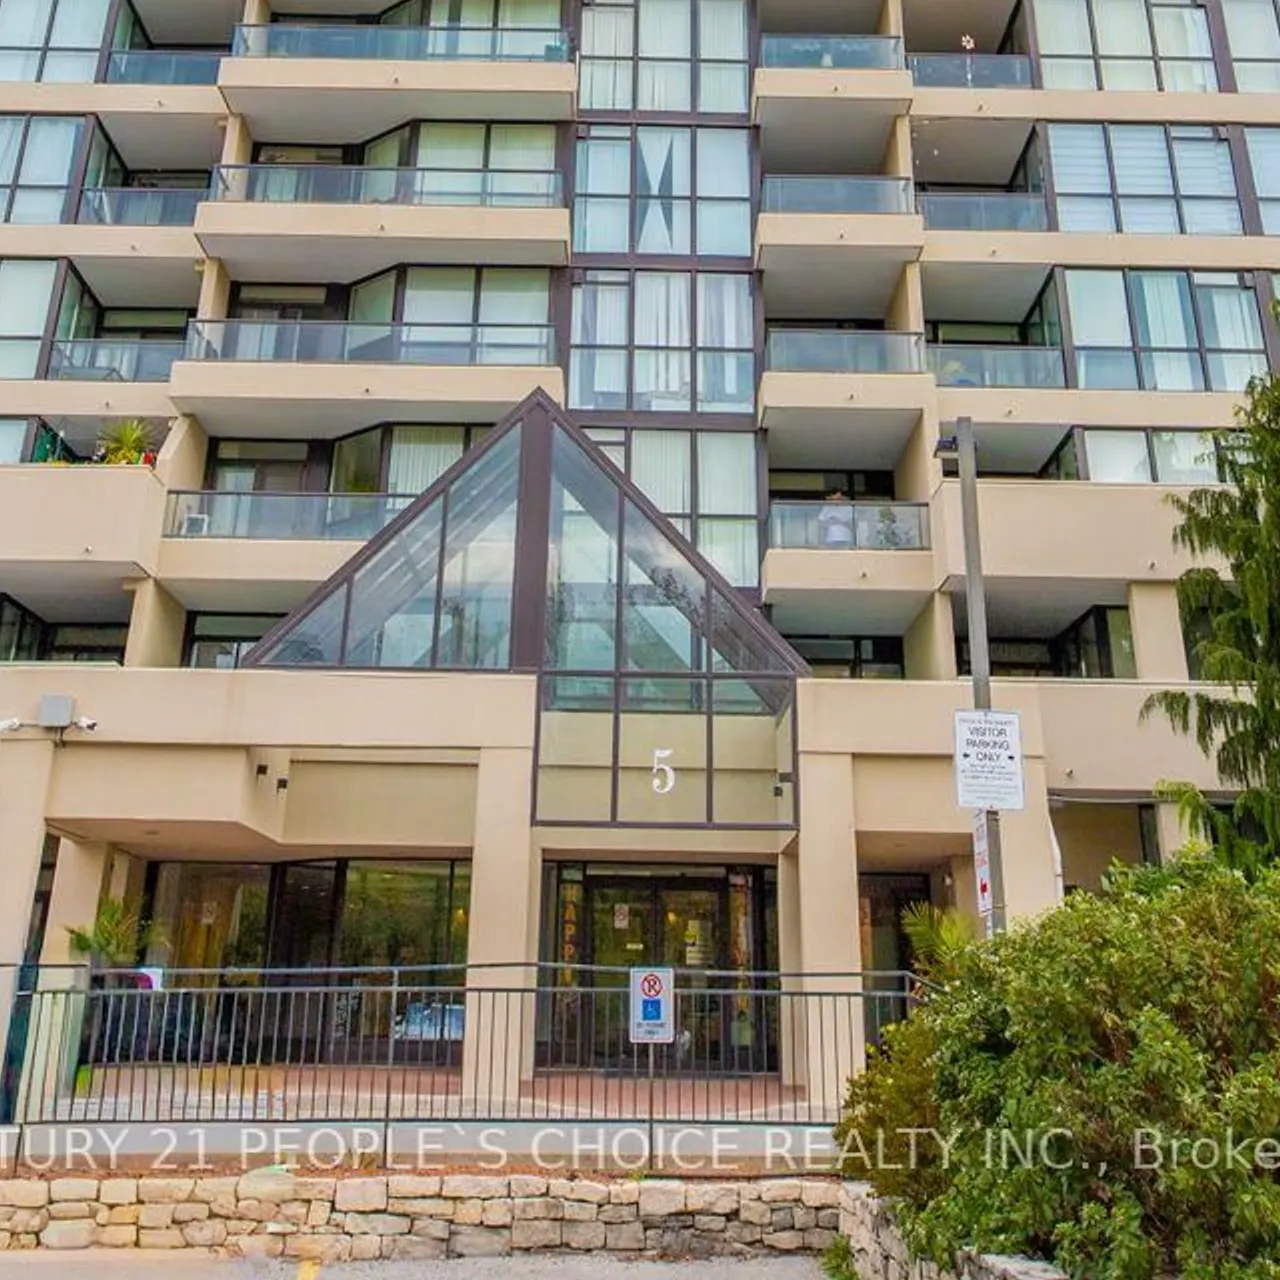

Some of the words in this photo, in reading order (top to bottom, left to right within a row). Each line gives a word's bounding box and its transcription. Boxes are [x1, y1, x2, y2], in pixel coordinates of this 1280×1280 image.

[968, 726, 1007, 737] VISITOR
[966, 738, 1010, 751] PARKING
[976, 751, 1001, 761] ONLY
[652, 748, 675, 793] 5
